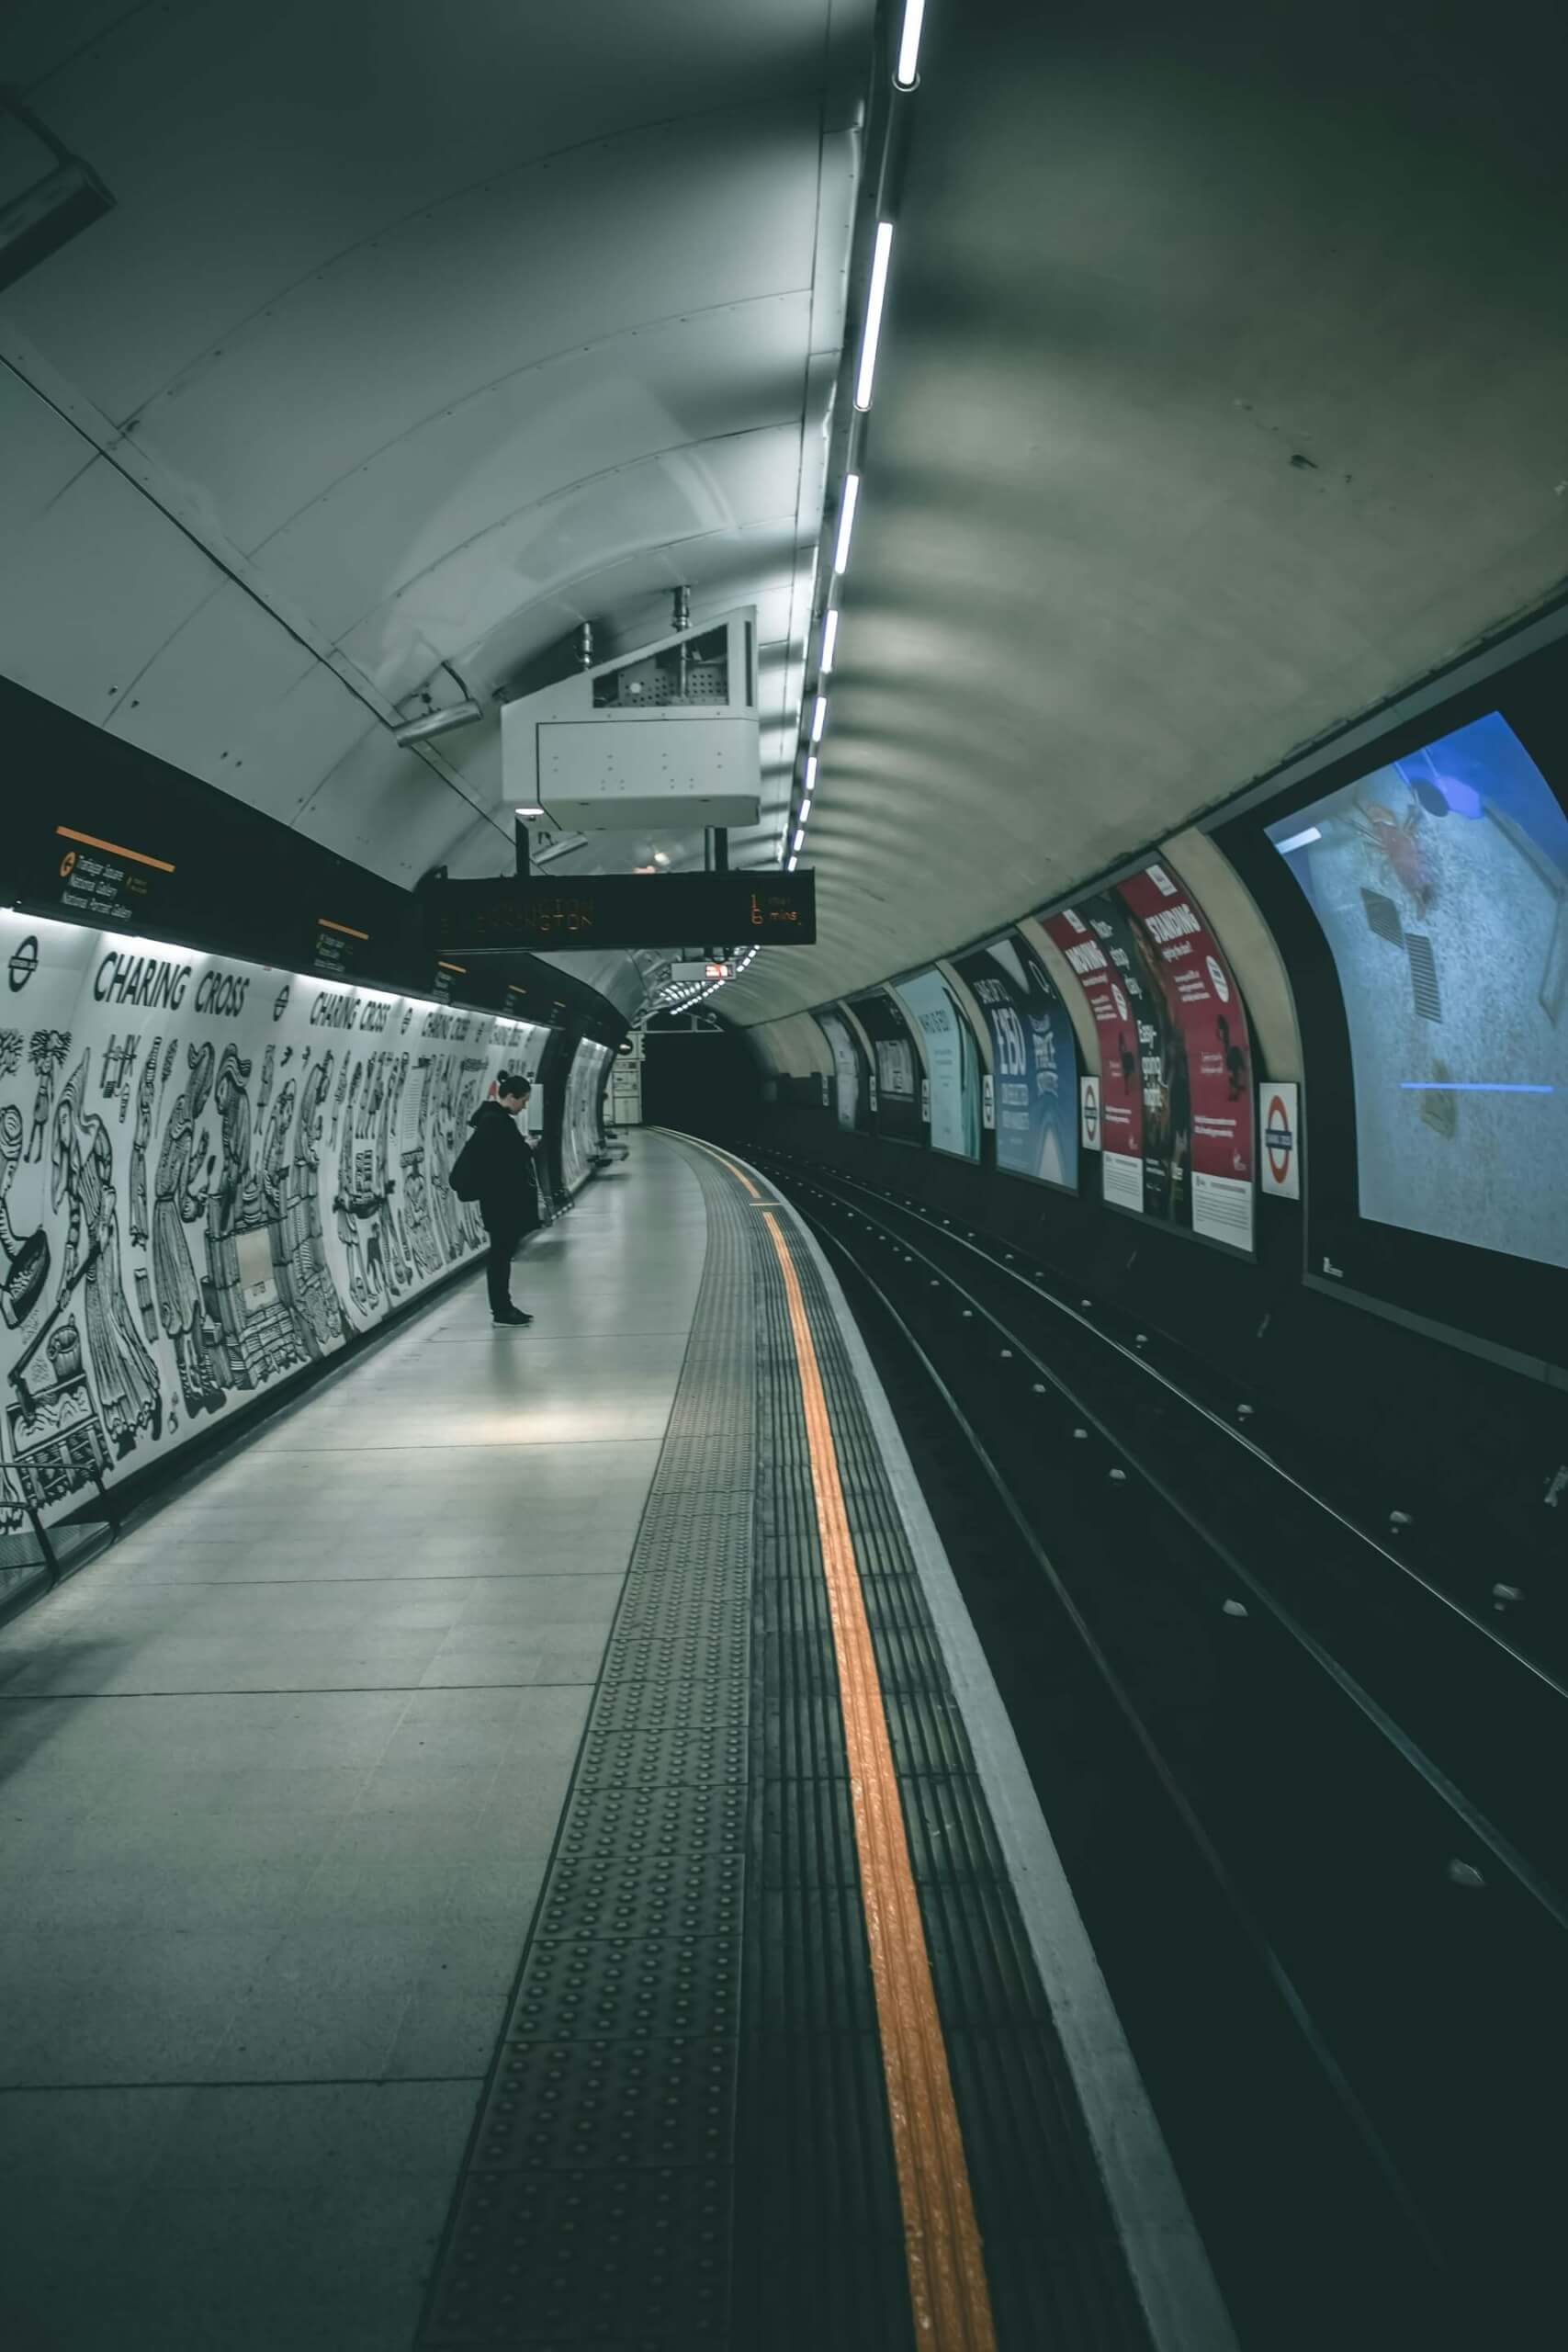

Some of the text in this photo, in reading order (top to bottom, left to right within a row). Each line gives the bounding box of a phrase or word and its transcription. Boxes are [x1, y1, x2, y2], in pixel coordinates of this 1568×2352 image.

[94, 951, 250, 1018] CHARING CROSS
[310, 991, 391, 1033] CHARING CROSS
